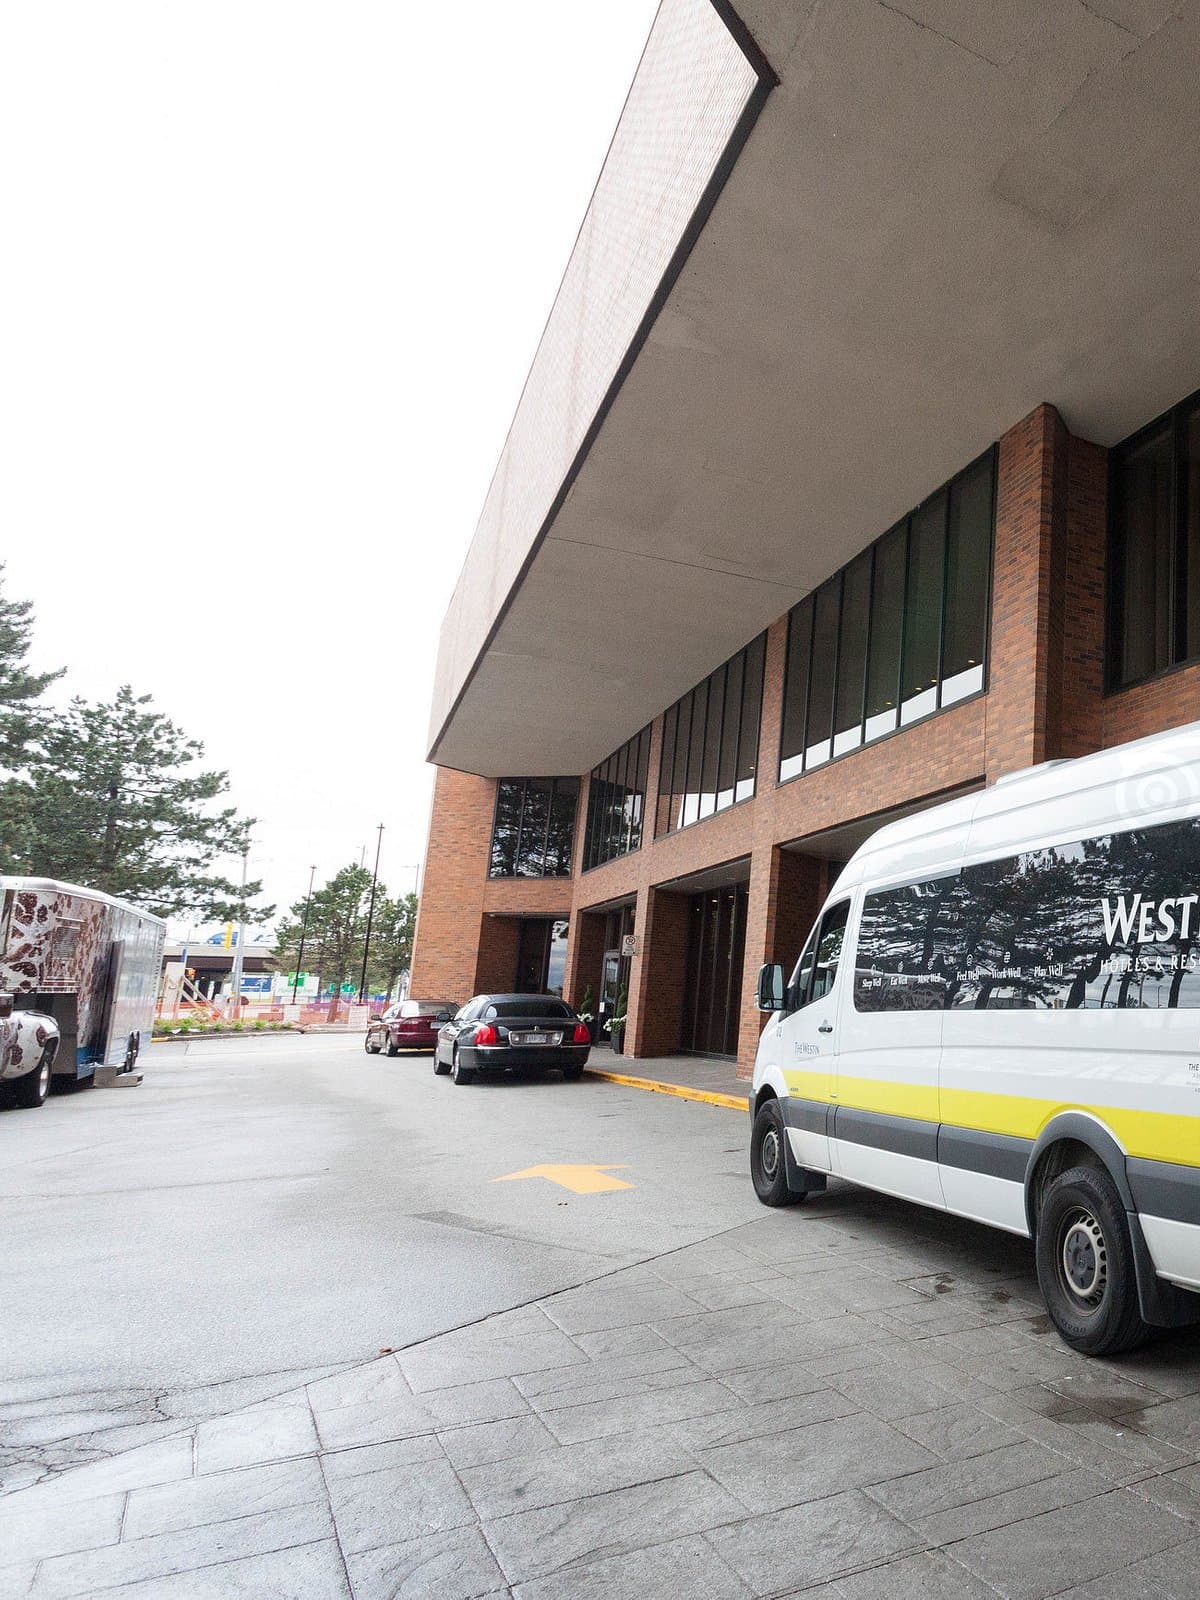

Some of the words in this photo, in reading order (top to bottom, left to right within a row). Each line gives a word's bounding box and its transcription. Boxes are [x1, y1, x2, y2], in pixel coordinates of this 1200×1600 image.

[1048, 963, 1064, 976] Well
[1100, 956, 1149, 975] HOTELS
[1155, 956, 1166, 971] &
[1188, 1063, 1200, 1072] THE
